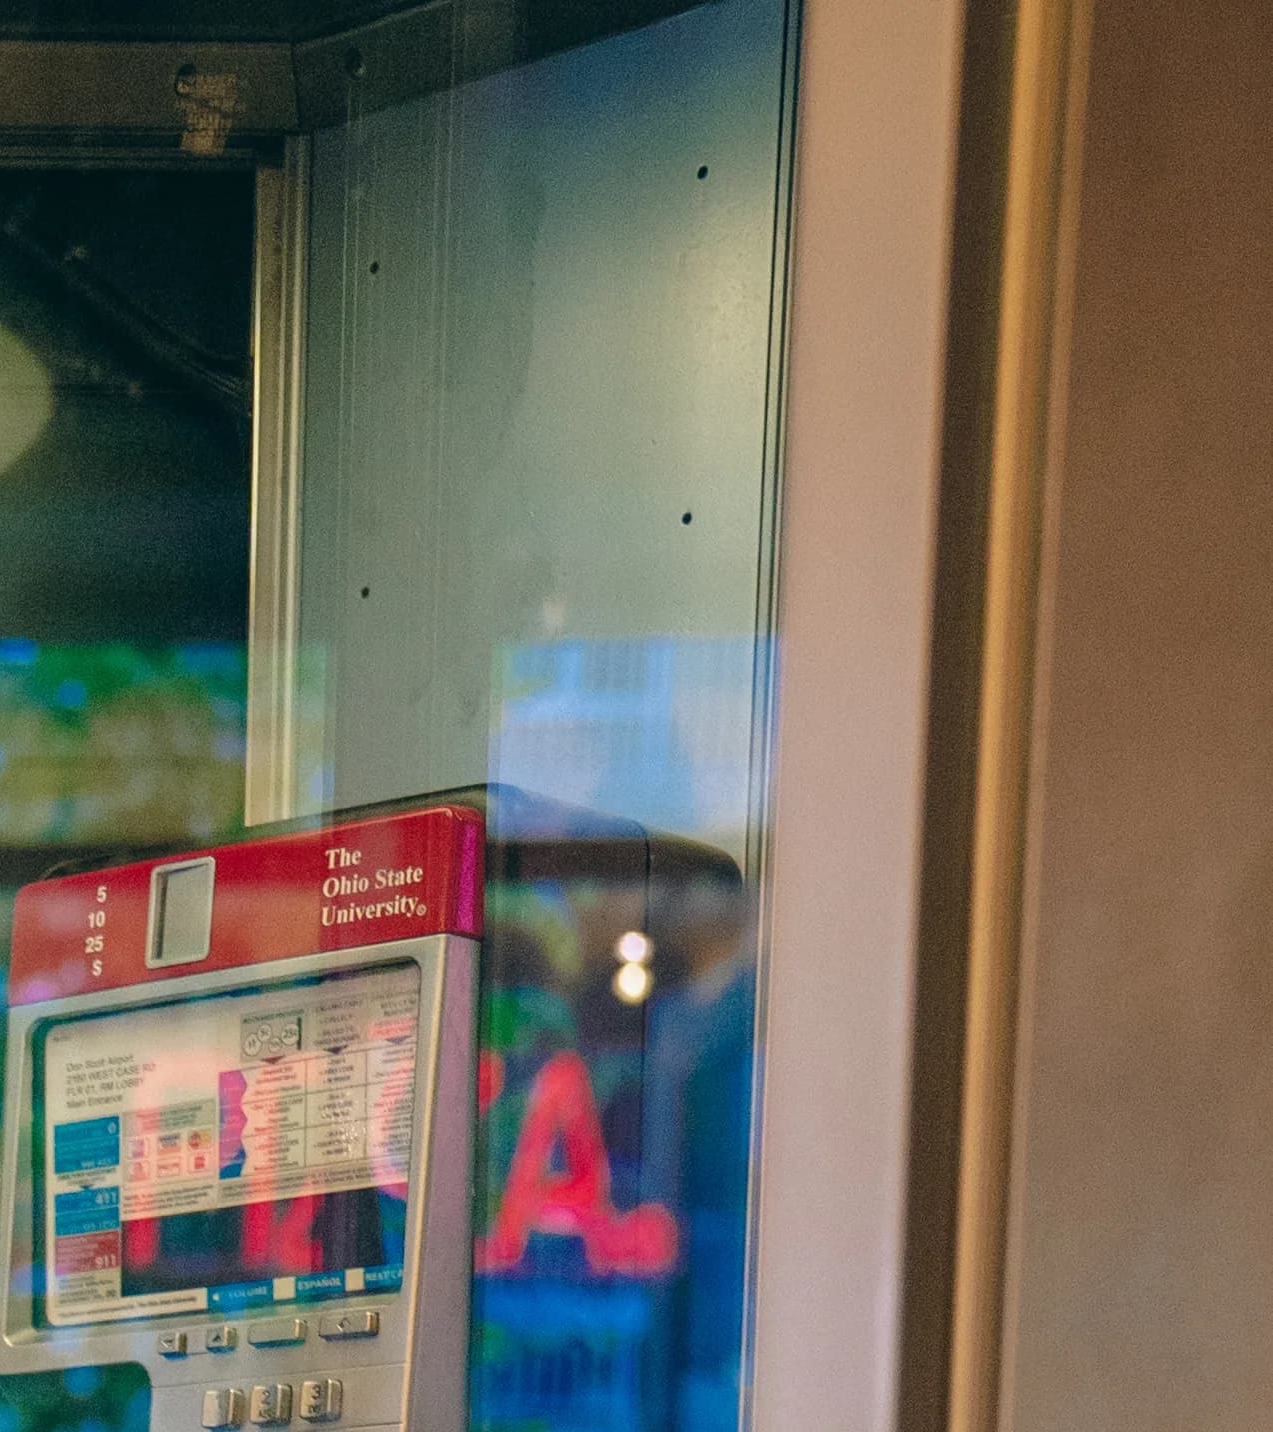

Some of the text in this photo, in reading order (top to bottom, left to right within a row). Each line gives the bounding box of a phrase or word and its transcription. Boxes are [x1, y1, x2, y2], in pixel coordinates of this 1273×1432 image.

[325, 847, 362, 870] The
[322, 867, 424, 899] Ohio State
[96, 886, 108, 903] 5
[87, 911, 106, 928] 10
[85, 935, 105, 953] 25
